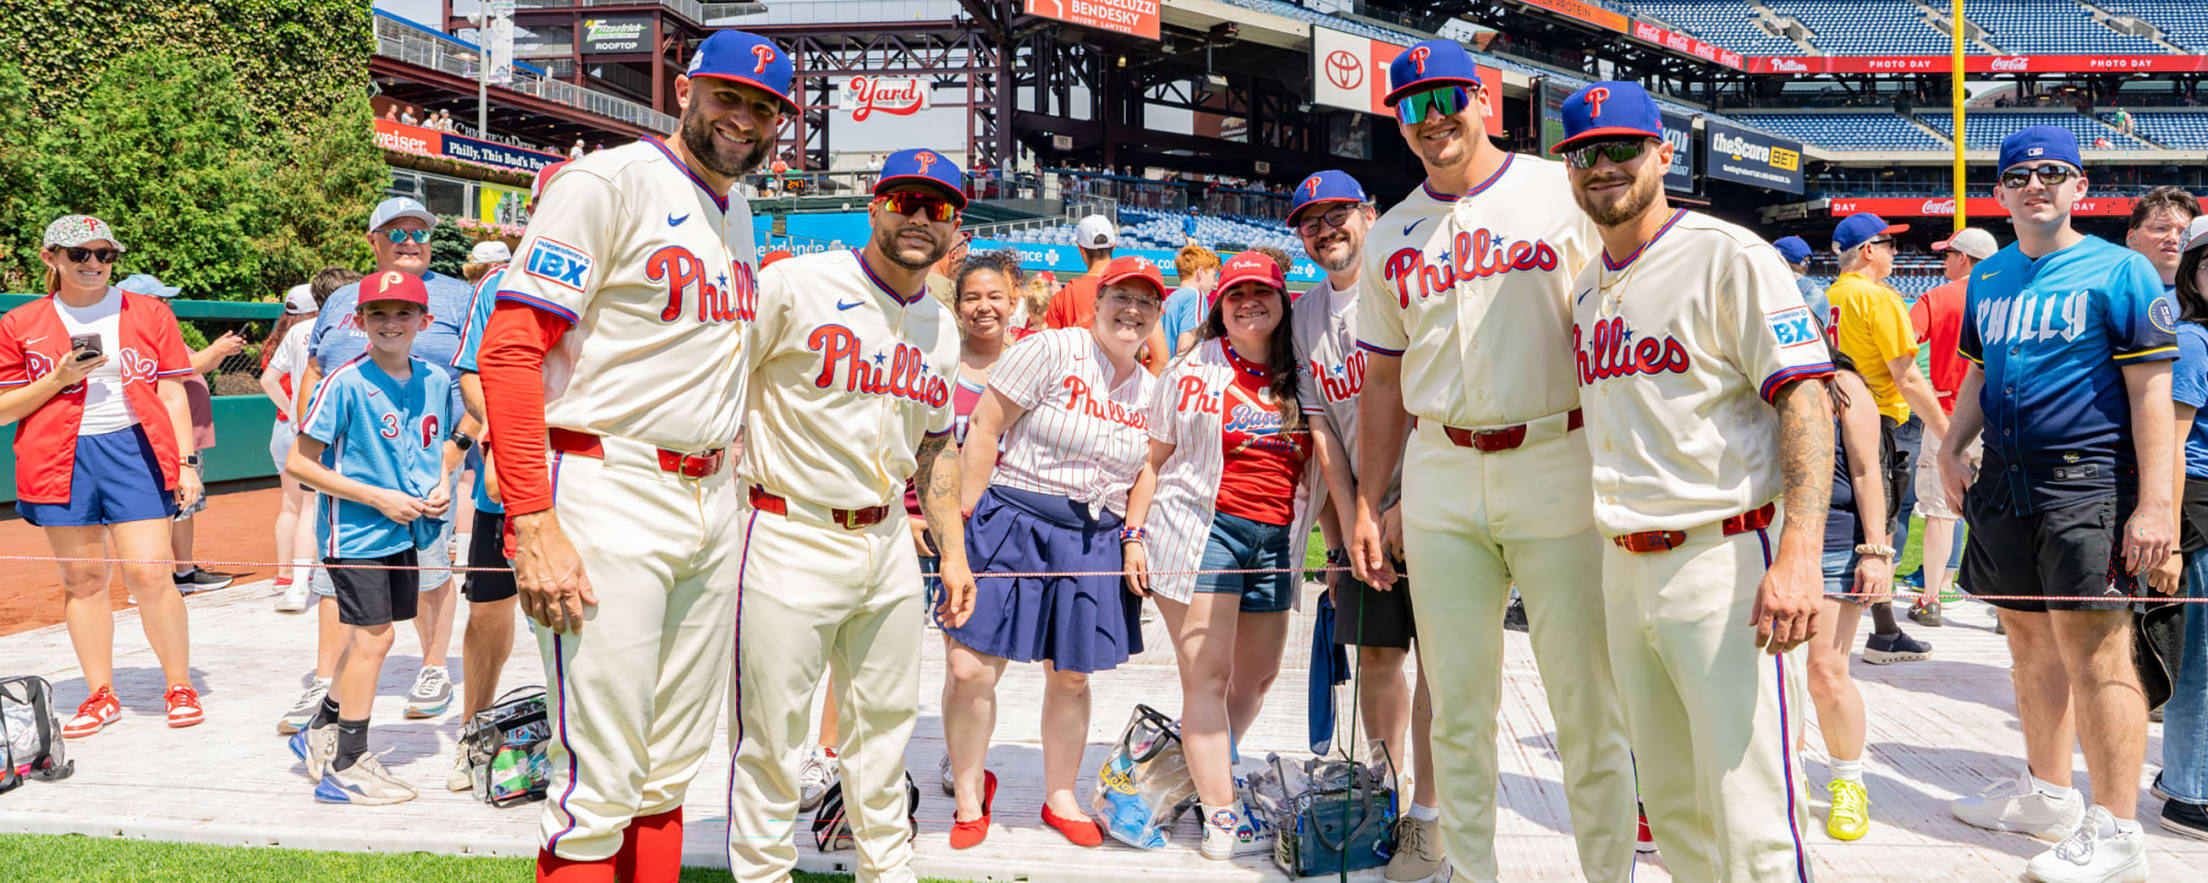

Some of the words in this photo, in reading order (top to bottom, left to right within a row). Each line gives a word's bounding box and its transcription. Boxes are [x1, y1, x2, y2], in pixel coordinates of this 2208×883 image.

[1072, 1, 1139, 26] BENDESKY
[595, 42, 638, 50] ROOFTOP
[751, 44, 777, 74] P
[1409, 46, 1431, 75] P
[1869, 60, 1905, 68] PHOTO
[1910, 60, 1931, 68] DAY
[1991, 57, 2028, 70] Coca-Cola
[2090, 60, 2126, 68] PHOTO
[2131, 60, 2152, 68] DAY
[849, 76, 923, 122] Yard
[1584, 87, 1610, 119] P
[449, 141, 481, 160] Philly,
[481, 147, 503, 163] This
[504, 152, 529, 168] Bud's
[914, 151, 937, 174] P
[1713, 132, 1770, 162] theScore
[1772, 150, 1797, 168] BET
[1305, 176, 1322, 198] P
[1834, 203, 1857, 212] DAY
[2073, 202, 2096, 212] DAY
[83, 218, 99, 231] P
[379, 271, 403, 293] P
[527, 248, 588, 287] IBX
[1384, 228, 1558, 309] Phillies
[1976, 290, 2089, 345] PHILLY
[807, 323, 949, 409] Phillies
[1063, 375, 1148, 431] Phillies
[381, 413, 399, 438] 3
[421, 413, 438, 448] P
